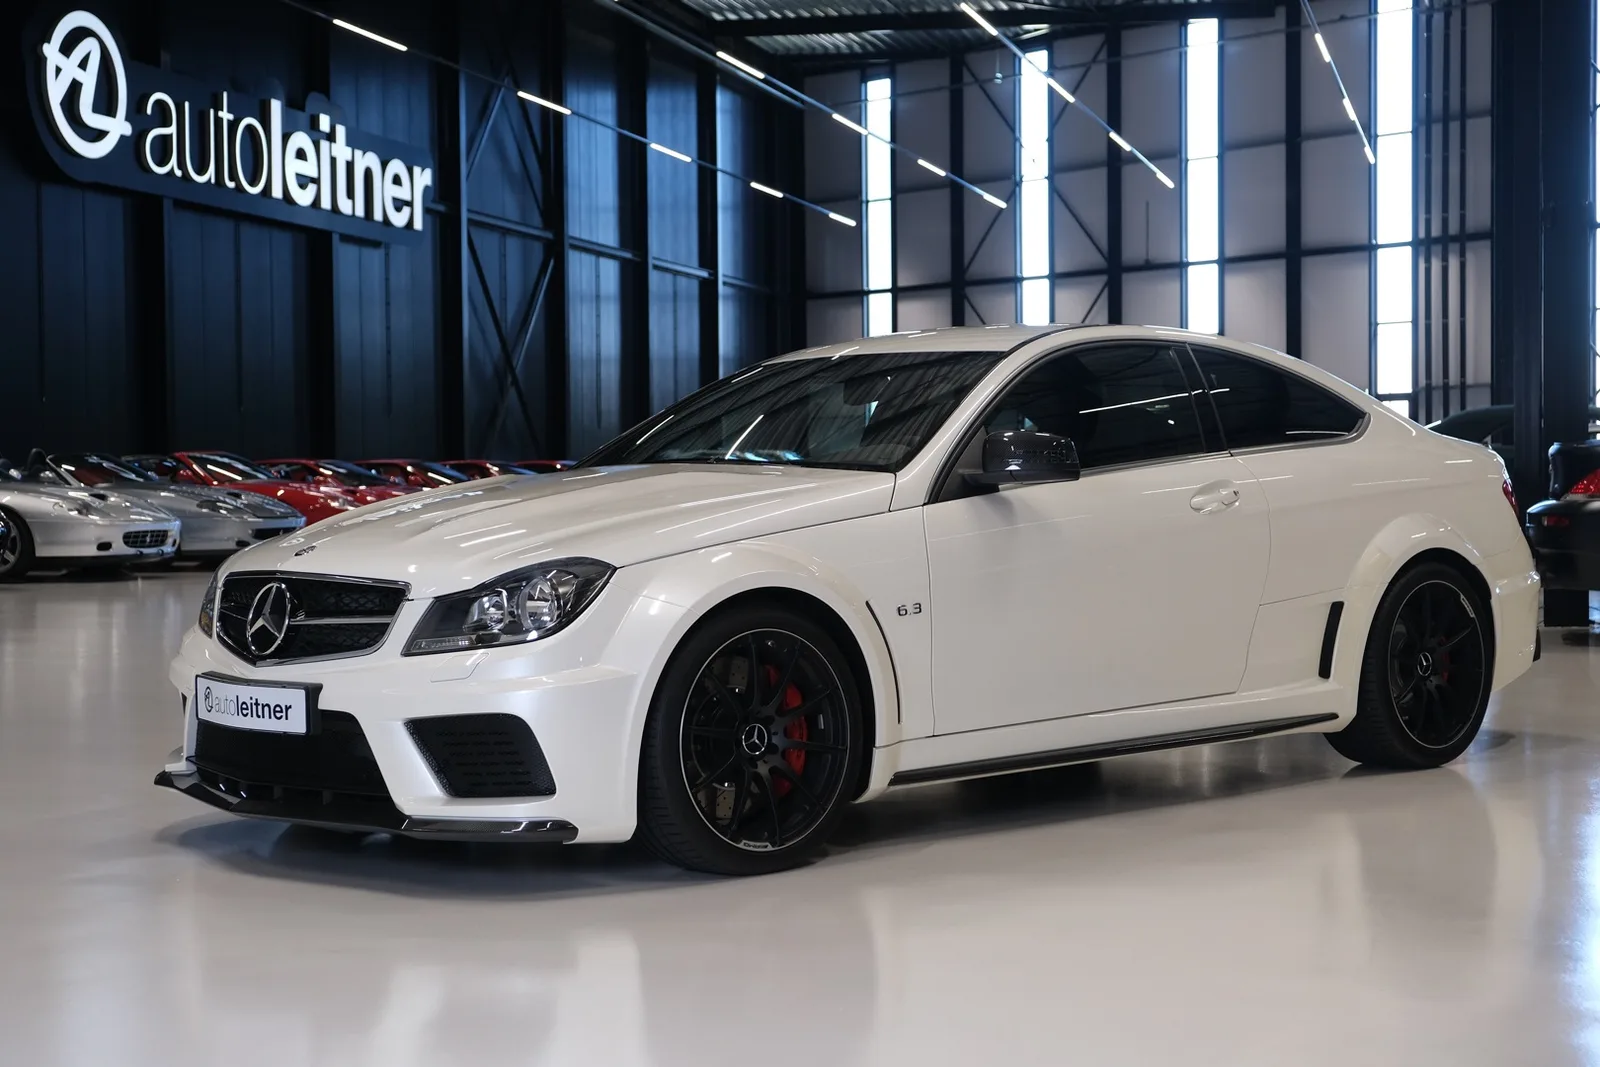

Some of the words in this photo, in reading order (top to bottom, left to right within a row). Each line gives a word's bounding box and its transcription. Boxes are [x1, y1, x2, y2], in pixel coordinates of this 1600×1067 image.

[145, 91, 432, 231] autoleitner
[897, 602, 922, 617] 6.3
[214, 695, 292, 720] autoleitner
